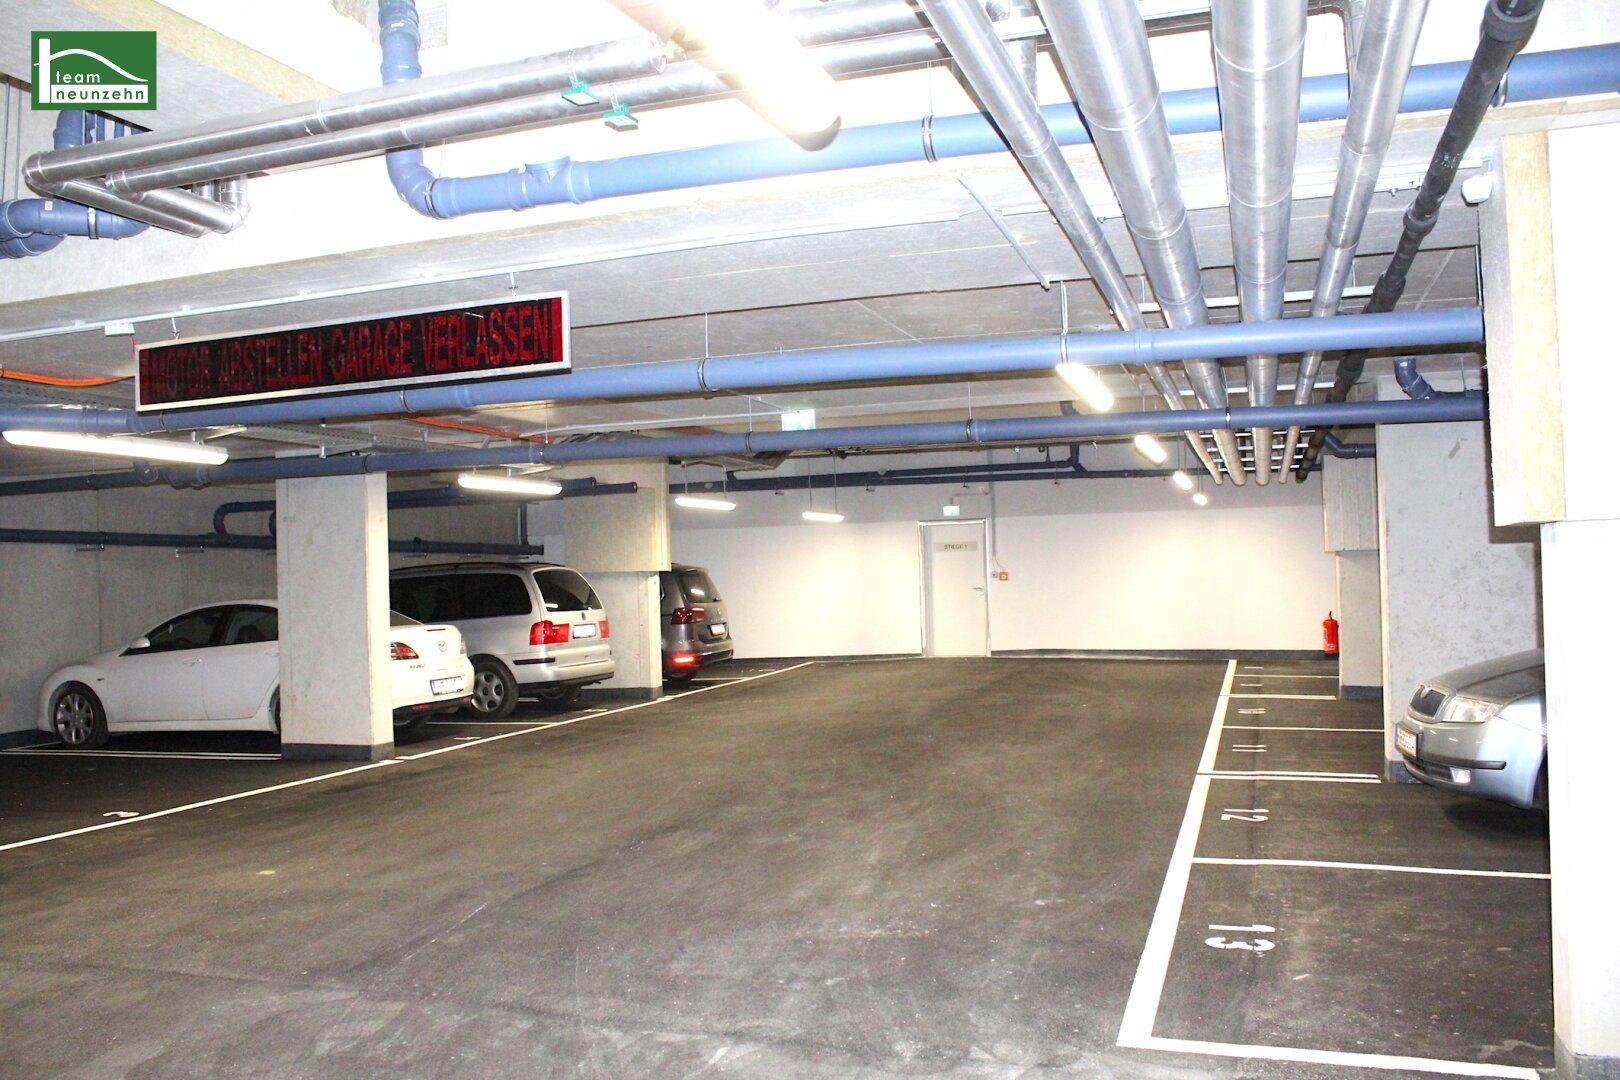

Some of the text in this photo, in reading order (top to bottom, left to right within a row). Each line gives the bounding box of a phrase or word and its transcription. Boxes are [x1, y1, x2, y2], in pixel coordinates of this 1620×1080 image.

[219, 329, 323, 393] ABSTELLEN
[332, 318, 413, 382] GARAGE
[420, 303, 550, 372] VERLASSEN
[1220, 808, 1269, 823] 12
[1204, 924, 1276, 952] 13
